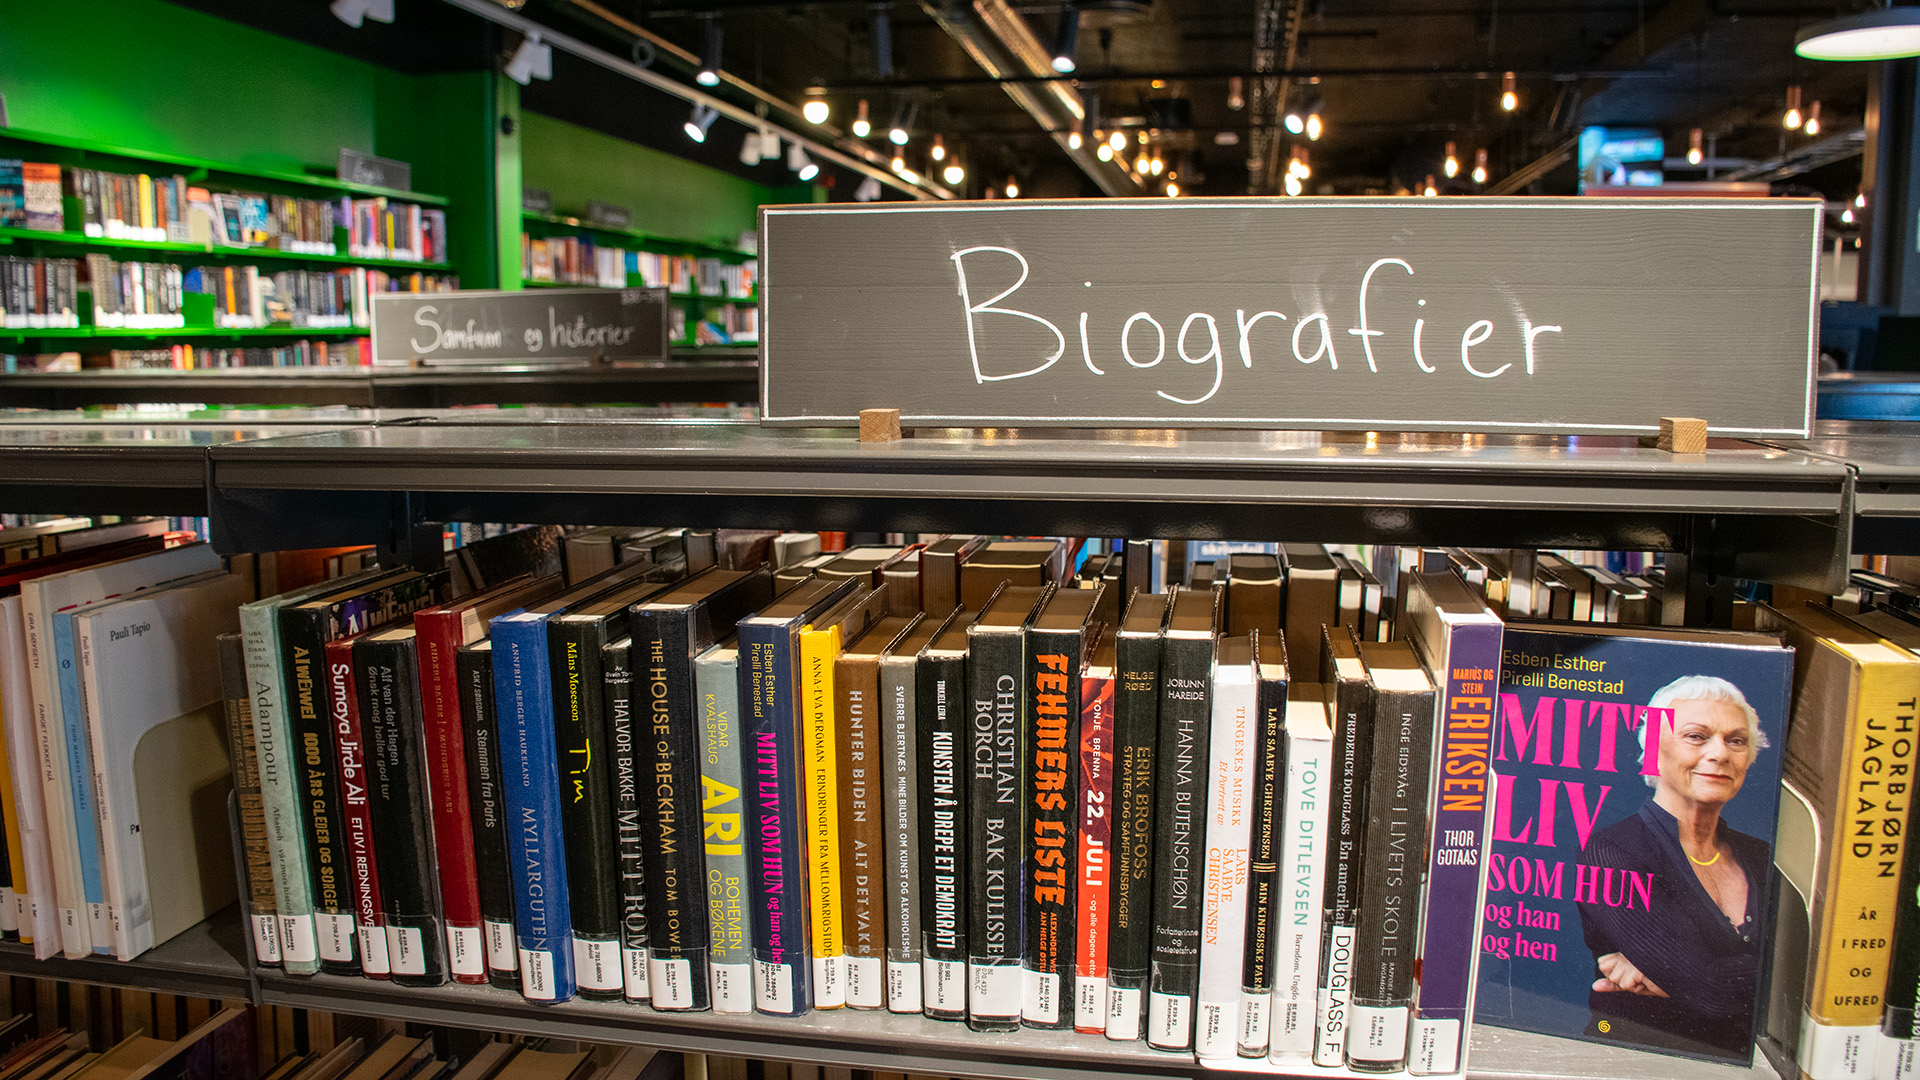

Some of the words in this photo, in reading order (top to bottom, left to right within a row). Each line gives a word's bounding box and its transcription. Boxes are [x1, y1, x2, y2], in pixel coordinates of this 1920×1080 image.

[523, 327, 544, 352] og
[548, 306, 635, 348] historier
[949, 244, 1563, 406] Biografier
[27, 612, 36, 630] EIRA
[109, 626, 130, 641] Pauli
[130, 621, 152, 637] Tapio
[30, 632, 40, 668] SØYSETH
[566, 641, 578, 671] Måns
[650, 639, 663, 663] THE
[751, 643, 762, 670] Pirelli
[763, 643, 774, 673] Esben
[1502, 649, 1550, 668] Esben
[1553, 653, 1607, 673] Esther
[380, 666, 392, 682] Alf
[382, 683, 394, 705] van
[752, 671, 764, 718] Benestad
[764, 675, 776, 706] Esther
[812, 656, 823, 710] ANNA-EVA
[1123, 671, 1155, 680] HELGE
[1124, 682, 1152, 691] RØED
[1166, 678, 1205, 688] JORUNN
[1453, 668, 1482, 680] MARIUS
[1483, 669, 1494, 681] OG
[1461, 682, 1484, 694] STEIN
[1501, 670, 1545, 689] Pirelli
[1547, 675, 1625, 695] Benestad
[330, 663, 353, 735] Sumaya
[384, 707, 398, 726] der
[568, 673, 580, 721] Mosesson
[650, 668, 670, 735] HOUSE
[895, 685, 905, 721] SVERRE
[1093, 698, 1102, 731] TONJE
[1167, 690, 1205, 701] HAREIDE
[38, 704, 49, 734] FARGET
[255, 680, 280, 785] Adampour
[614, 699, 632, 753] HALVOR
[705, 694, 718, 764] KVALSHAUG
[717, 711, 729, 748] VIDAR
[813, 712, 825, 762] BERGMAN
[848, 689, 865, 762] HUNTER
[975, 699, 993, 780] BORCH
[996, 674, 1015, 804] CHRISTIAN
[1034, 653, 1069, 811] FEHMERS
[1233, 706, 1246, 773] TINGENES
[1266, 707, 1277, 736] LARS
[1400, 712, 1412, 743] INGE
[1494, 692, 1675, 777] MITT
[42, 735, 52, 770] FLEKKET
[302, 733, 319, 765] 1000
[339, 738, 361, 779] Jirde
[384, 728, 401, 766] Hagen
[476, 729, 493, 780] Stemmen
[656, 741, 670, 759] OF
[756, 731, 778, 779] MITT
[896, 723, 906, 772] BJERTNÆS
[932, 731, 954, 794] KUNSTEN
[1092, 737, 1101, 779] BRENNA
[1176, 720, 1194, 785] HANNA
[1265, 738, 1275, 780] SAABYE
[1344, 712, 1357, 776] FREDERICK
[1442, 696, 1492, 811] ERIKSEN
[46, 770, 54, 782] NÅ
[307, 769, 325, 797] ÅRS
[568, 738, 591, 803] Tim
[617, 757, 635, 801] BAKKE
[898, 776, 907, 798] MINE
[1135, 746, 1151, 788] ERIK
[1301, 758, 1317, 811] TOVE
[1396, 747, 1410, 798] EIDSVÅG
[1853, 718, 1886, 858] JAGLAND
[1877, 697, 1916, 878] THORBJØRN
[344, 781, 366, 805] Ali
[481, 781, 494, 798] fra
[655, 762, 677, 855] BECKHAM
[758, 781, 779, 812] LIV
[816, 768, 828, 836] ERINDRINGER
[852, 768, 866, 822] BIDEN
[933, 797, 958, 807] Å
[1087, 790, 1104, 825] 22.
[1231, 778, 1243, 827] MUSIKK
[1340, 778, 1353, 835] DOUGLASS
[311, 799, 329, 844] GLEDER
[483, 799, 496, 828] Paris
[701, 774, 743, 856] ARI
[898, 799, 908, 829] BILDER
[934, 811, 955, 853] DREPE
[1260, 782, 1275, 859] CHRISTENSEN
[1491, 774, 1612, 851] LIV
[319, 847, 333, 863] OG
[617, 807, 644, 885] MITT
[760, 814, 781, 854] SOM
[818, 839, 829, 859] FRA
[899, 833, 908, 847] OM
[986, 818, 1005, 863] BAK
[1133, 792, 1150, 880] BROFOSS
[1172, 791, 1191, 910] BUTENSCHØN
[1386, 821, 1407, 887] LIVETS
[1444, 830, 1475, 847] THOR
[763, 856, 783, 894] HUN
[899, 849, 909, 879] KUNST
[934, 856, 955, 873] ET
[1033, 818, 1067, 906] LISTE
[1085, 834, 1104, 886] JULI
[1220, 848, 1234, 903] SAABYE
[1235, 847, 1247, 885] LARS
[1294, 820, 1314, 926] DITLEVSEN
[1437, 849, 1478, 865] GOTAAS
[522, 806, 549, 951] MYLLARGUTEN
[709, 869, 722, 895] OG
[900, 881, 909, 895] OG
[1205, 847, 1221, 945] CHRISTENSEN
[1486, 853, 1564, 900] SOM
[1573, 863, 1655, 913] HUN
[725, 876, 742, 950] BOHEMEN
[767, 897, 781, 910] og
[769, 911, 784, 932] han
[820, 861, 833, 958] MELLOMKRIGSTIDEN
[935, 875, 956, 949] DEMOKRATI
[986, 868, 1005, 966] KULISSEN
[1485, 901, 1512, 931] og
[1516, 900, 1561, 931] han
[1858, 906, 1877, 921] ÅR
[710, 900, 726, 957] BØKENE
[769, 933, 784, 947] og
[901, 896, 911, 959] ALKOHOLISME
[1380, 895, 1401, 957] SKOLE
[1483, 933, 1511, 961] og
[1515, 931, 1557, 962] hen
[1841, 939, 1847, 949] I
[1852, 938, 1886, 949] FRED
[1325, 935, 1351, 1037] DOUGLASS,
[1849, 967, 1872, 978] OG
[1833, 995, 1879, 1006] UFRED
[1324, 1042, 1340, 1057] F.
